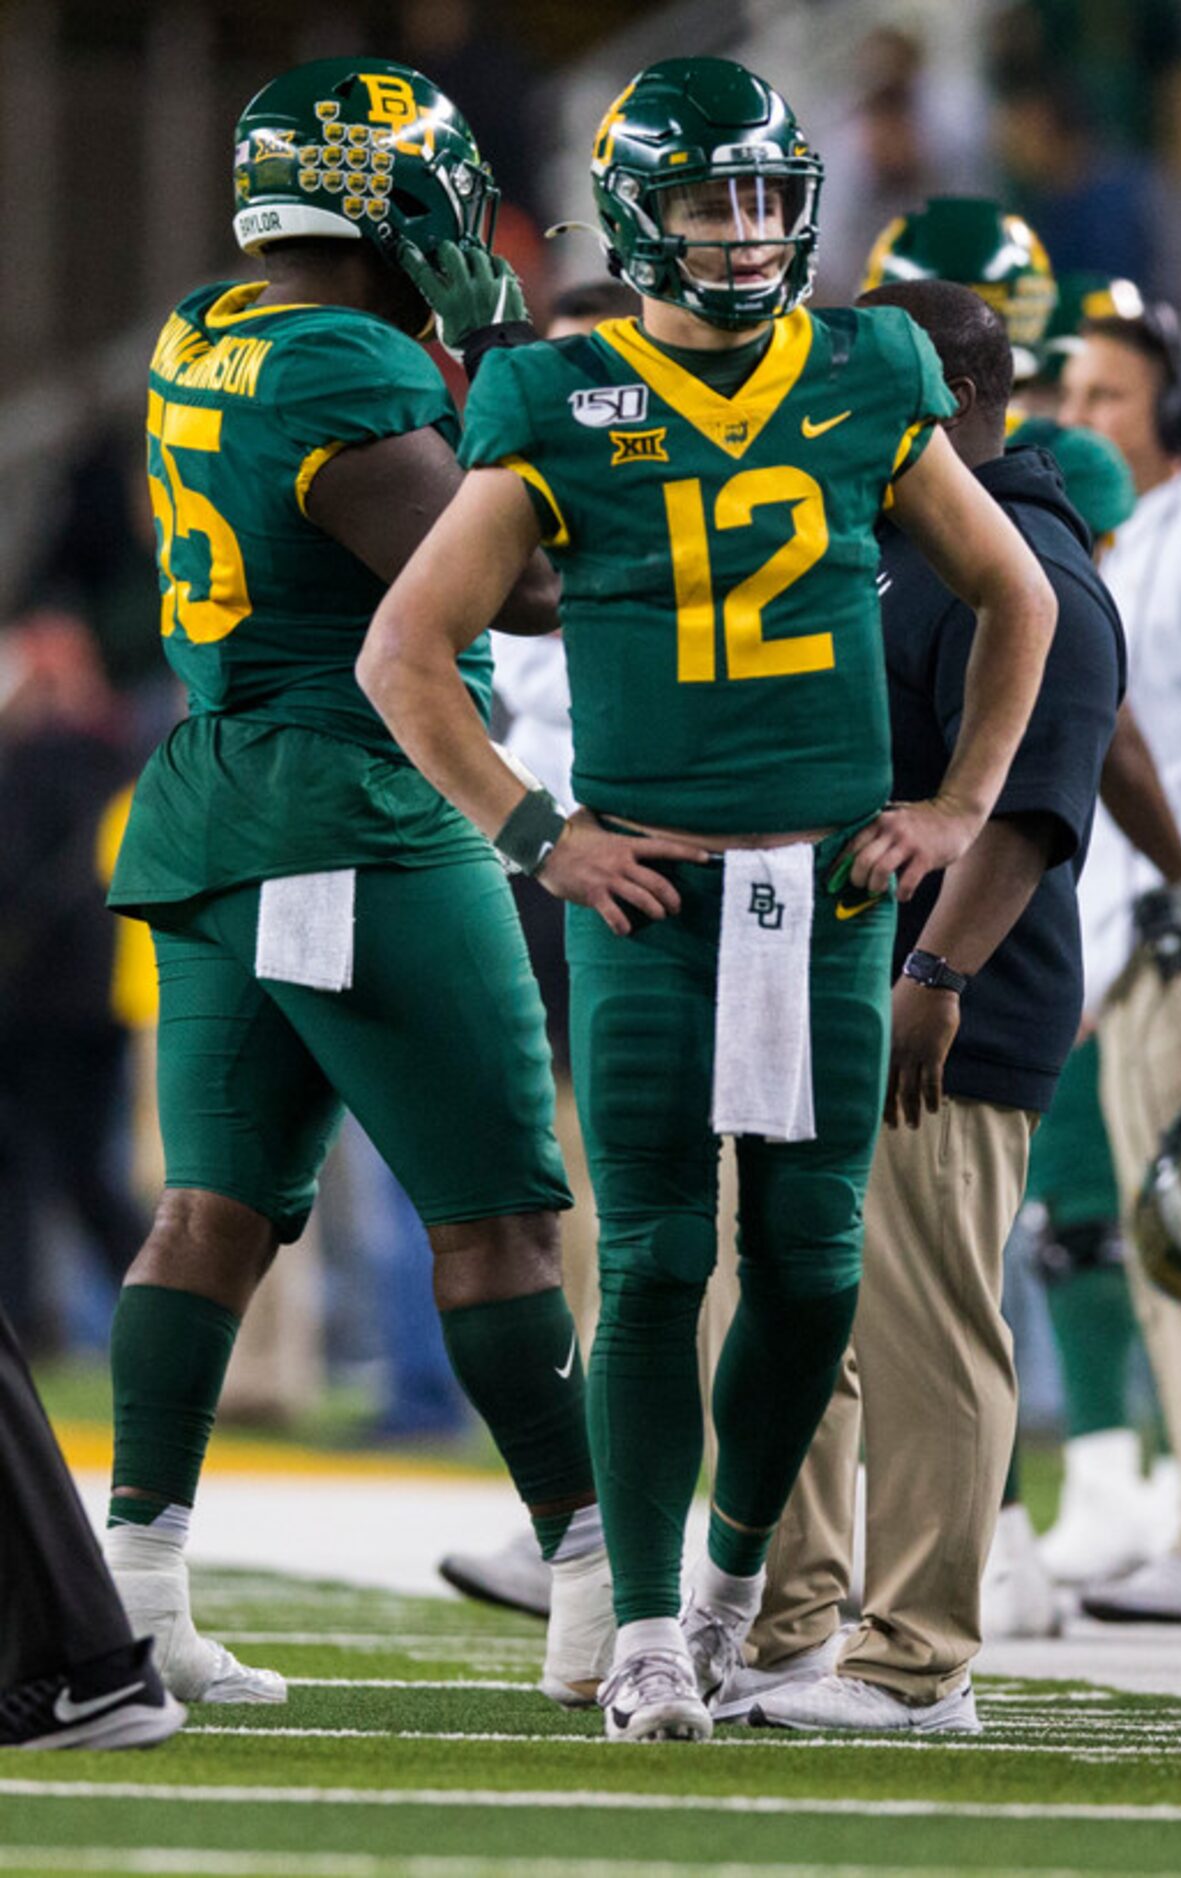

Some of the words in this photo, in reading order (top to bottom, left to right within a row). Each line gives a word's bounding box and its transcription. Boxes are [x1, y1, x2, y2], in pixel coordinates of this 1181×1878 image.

[572, 386, 646, 422] 150
[614, 434, 665, 460] XII
[663, 465, 835, 682] 12
[747, 882, 785, 930] BU
